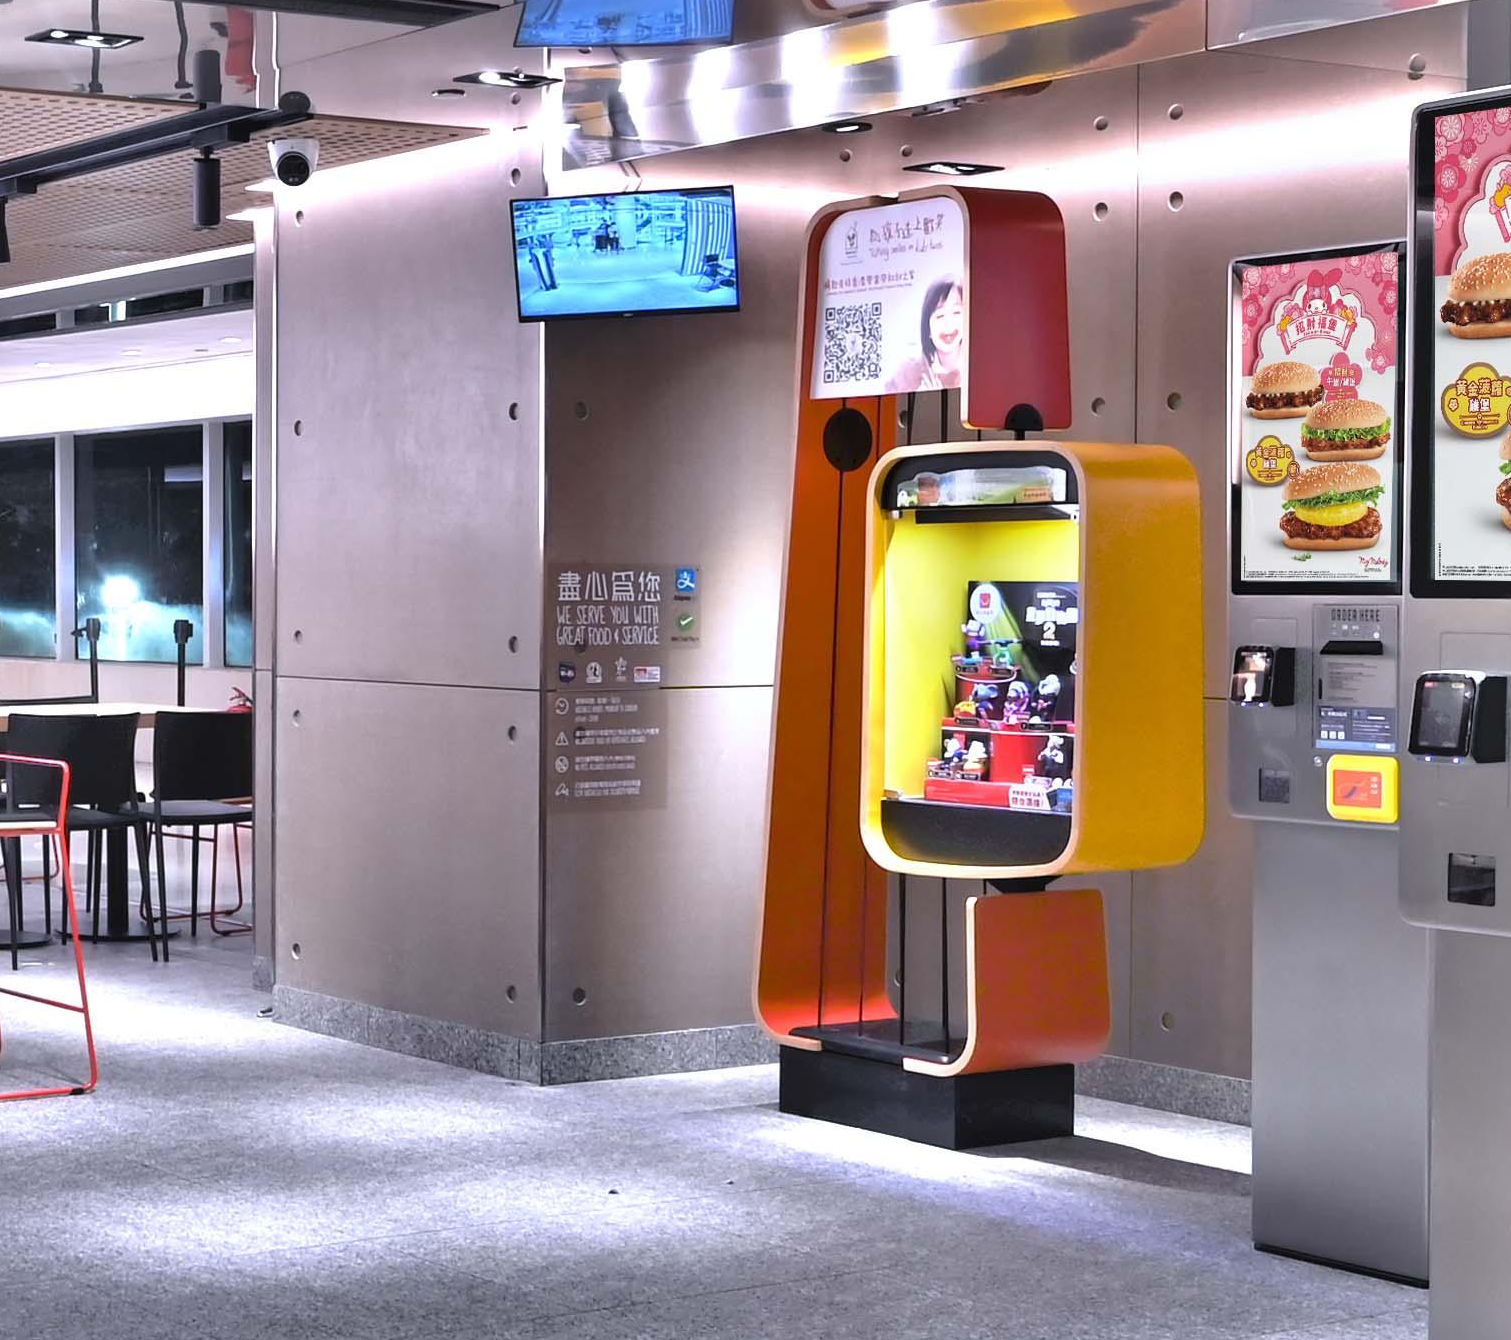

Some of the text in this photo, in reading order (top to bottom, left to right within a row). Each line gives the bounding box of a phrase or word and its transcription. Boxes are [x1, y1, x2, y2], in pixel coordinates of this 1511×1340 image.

[556, 605, 659, 625] WE SERVE YOU WITH
[1330, 608, 1381, 623] ORDER HERE
[556, 625, 586, 646] GREAT
[587, 626, 612, 645] FOOD
[622, 625, 661, 645] SERVICE
